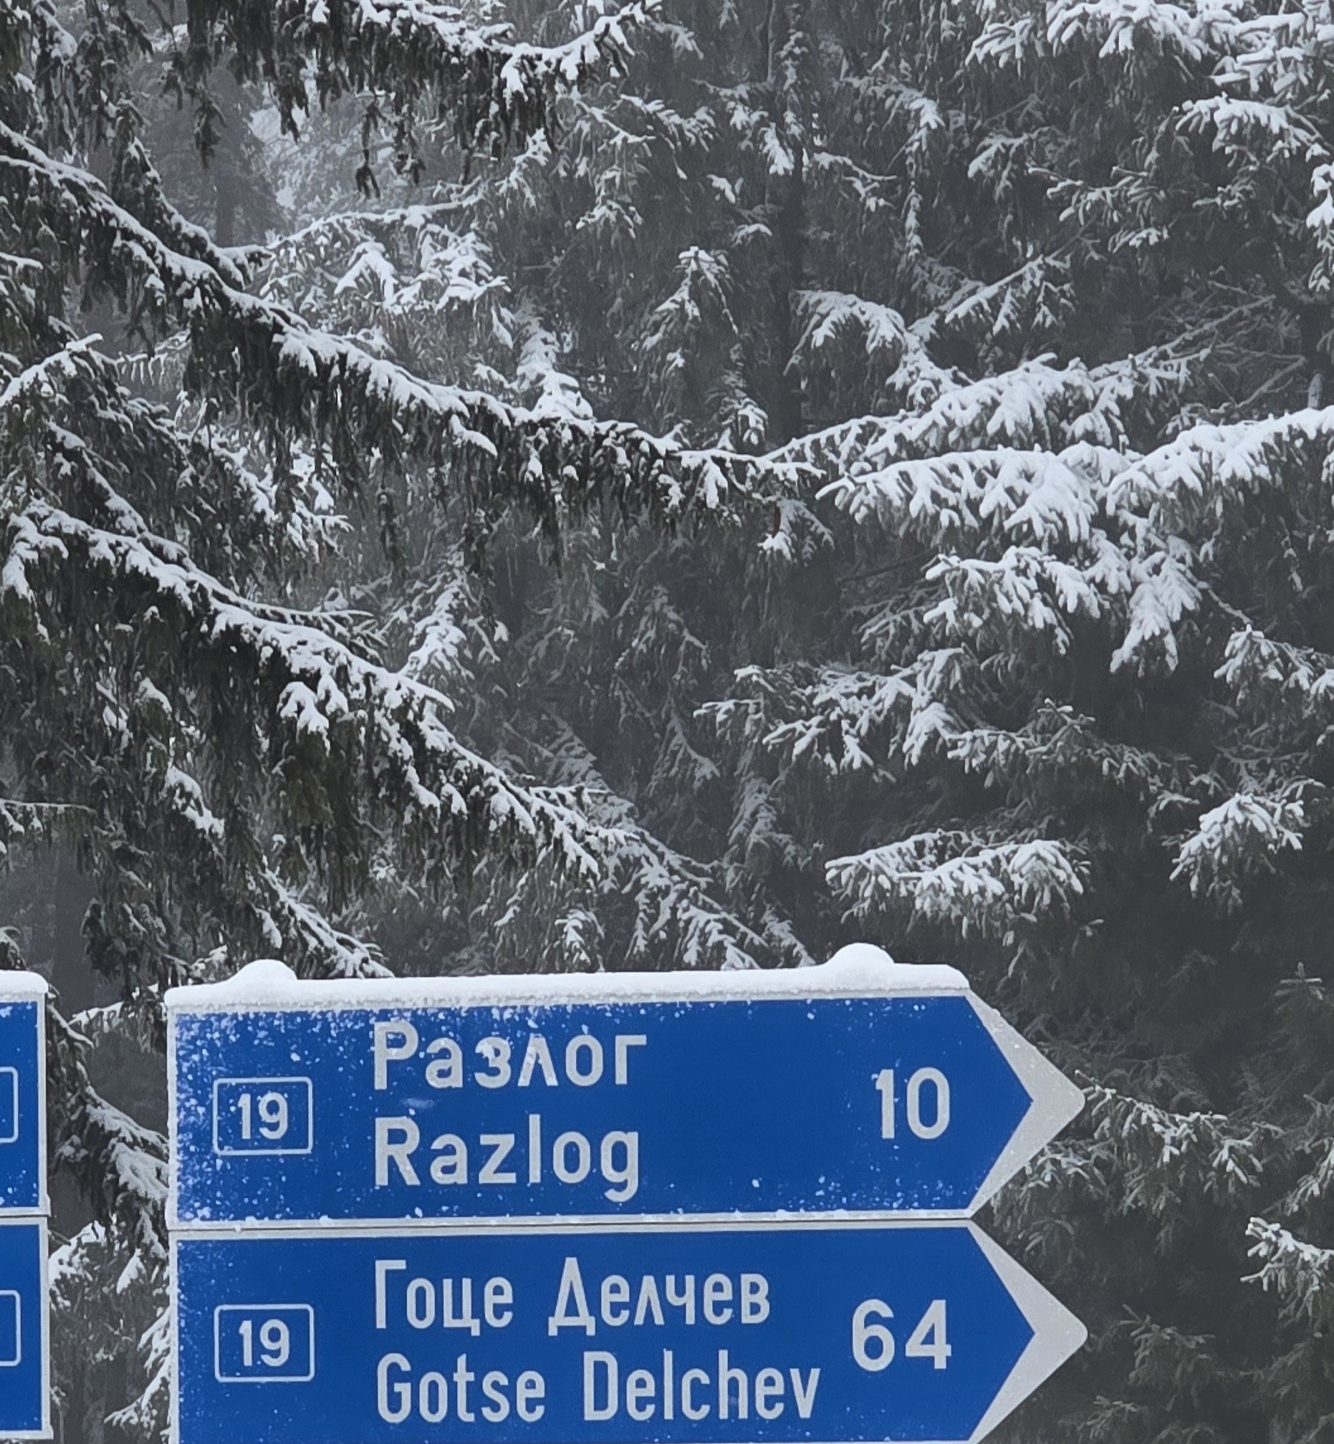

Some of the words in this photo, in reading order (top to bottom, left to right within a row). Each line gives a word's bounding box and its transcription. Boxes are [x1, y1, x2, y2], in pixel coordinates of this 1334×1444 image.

[371, 1020, 647, 1091] Разлог
[237, 1092, 288, 1140] 19
[873, 1067, 950, 1140] 10
[374, 1113, 640, 1203] Razlog
[374, 1259, 513, 1334] Гоце
[548, 1256, 770, 1337] Делчев
[238, 1318, 290, 1367] 19
[852, 1298, 952, 1372] 64
[377, 1352, 545, 1424] Gotse
[583, 1348, 821, 1421] Delchev
